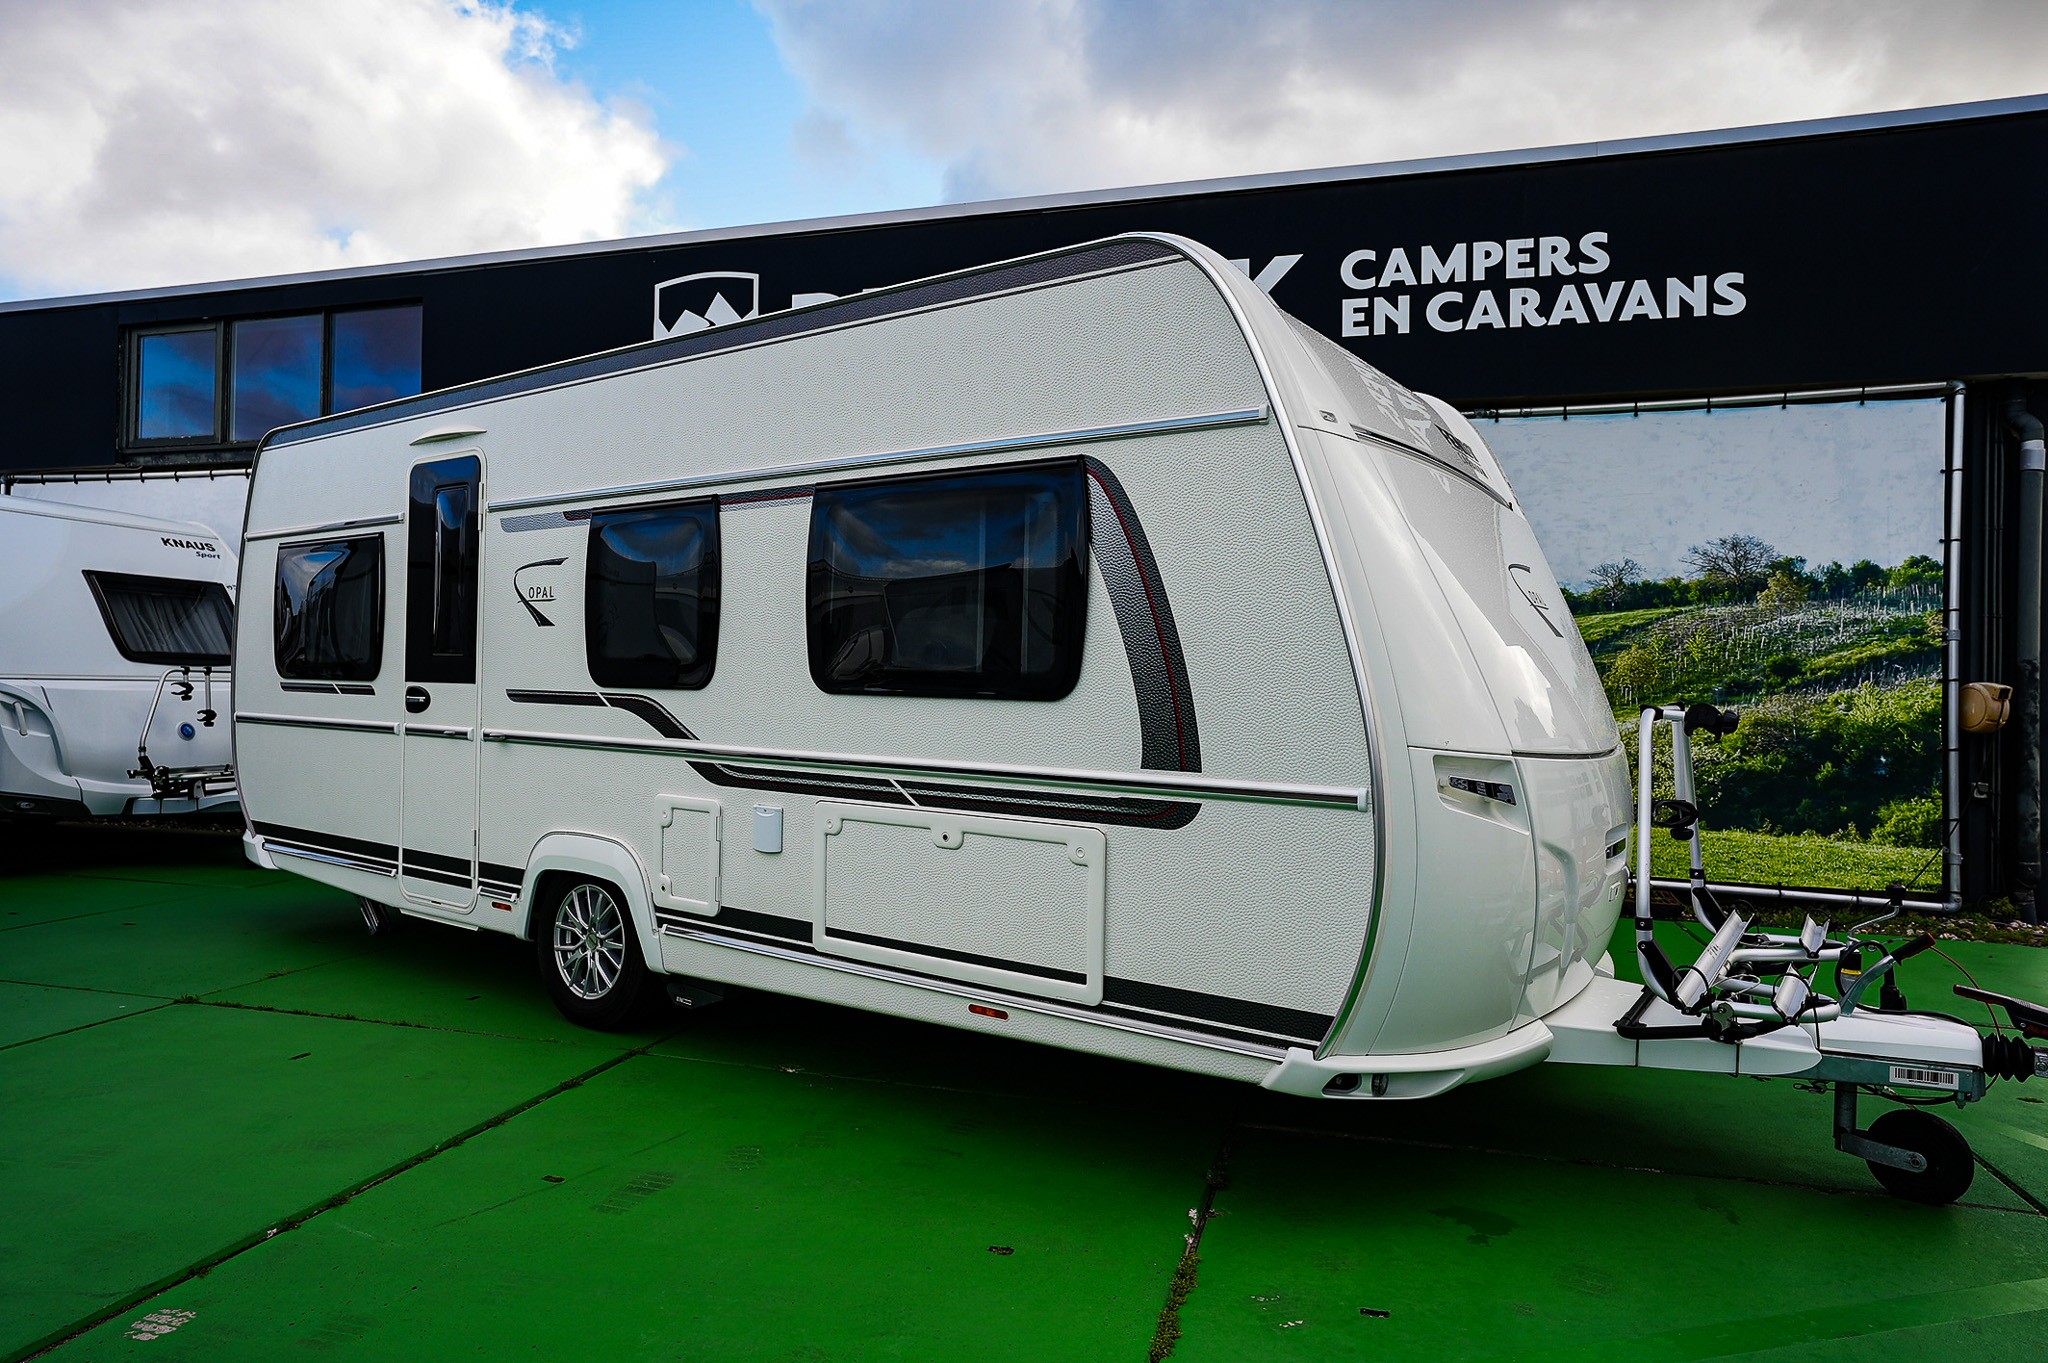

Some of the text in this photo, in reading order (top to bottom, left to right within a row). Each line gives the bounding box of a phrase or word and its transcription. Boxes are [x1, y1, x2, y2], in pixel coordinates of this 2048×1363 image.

[1340, 231, 1611, 290] CAMPERS
[1341, 271, 1747, 337] EN CARAVANS
[160, 537, 216, 552] KNAUS
[195, 551, 221, 560] Sport
[528, 586, 555, 599] OPAL
